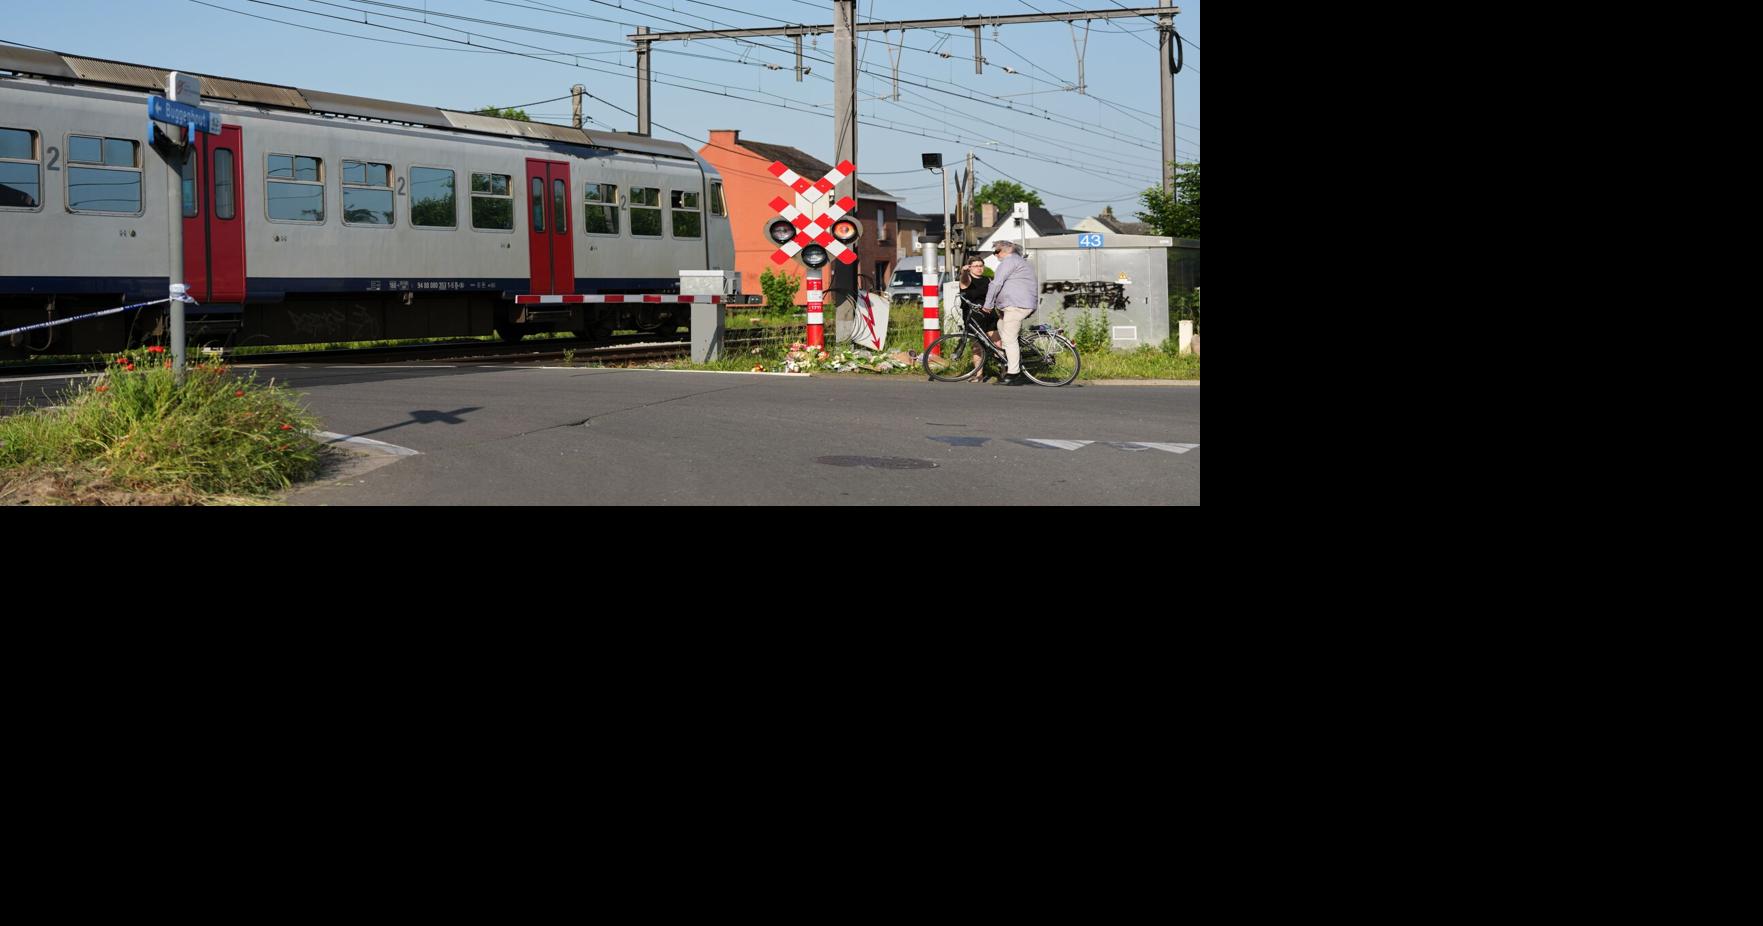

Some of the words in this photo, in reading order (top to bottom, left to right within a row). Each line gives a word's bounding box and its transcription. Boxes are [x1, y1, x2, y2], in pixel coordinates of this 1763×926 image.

[165, 102, 207, 128] Buggenhout
[47, 146, 60, 170] 2
[398, 176, 406, 195] 2
[621, 194, 627, 211] 2
[1080, 234, 1102, 247] 43
